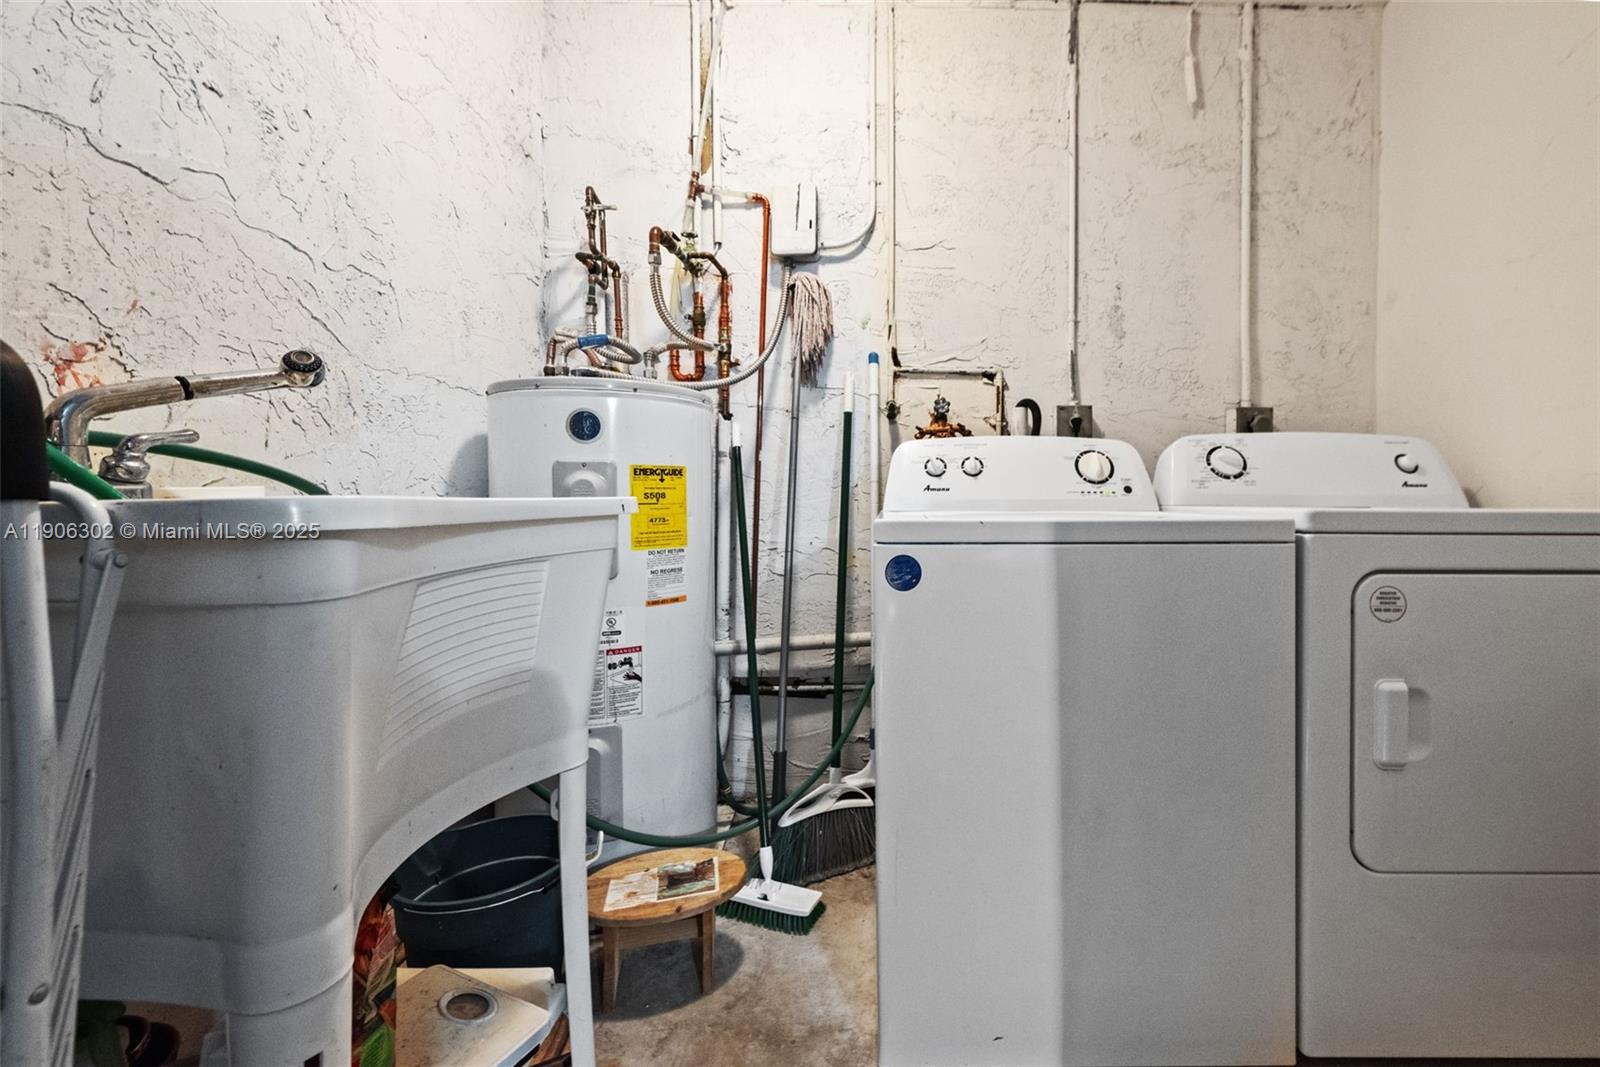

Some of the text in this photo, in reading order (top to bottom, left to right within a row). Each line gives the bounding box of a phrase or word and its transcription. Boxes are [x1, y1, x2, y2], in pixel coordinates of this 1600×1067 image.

[923, 484, 951, 492] Amana
[1401, 480, 1428, 488] Amana
[614, 646, 641, 654] DANGER
